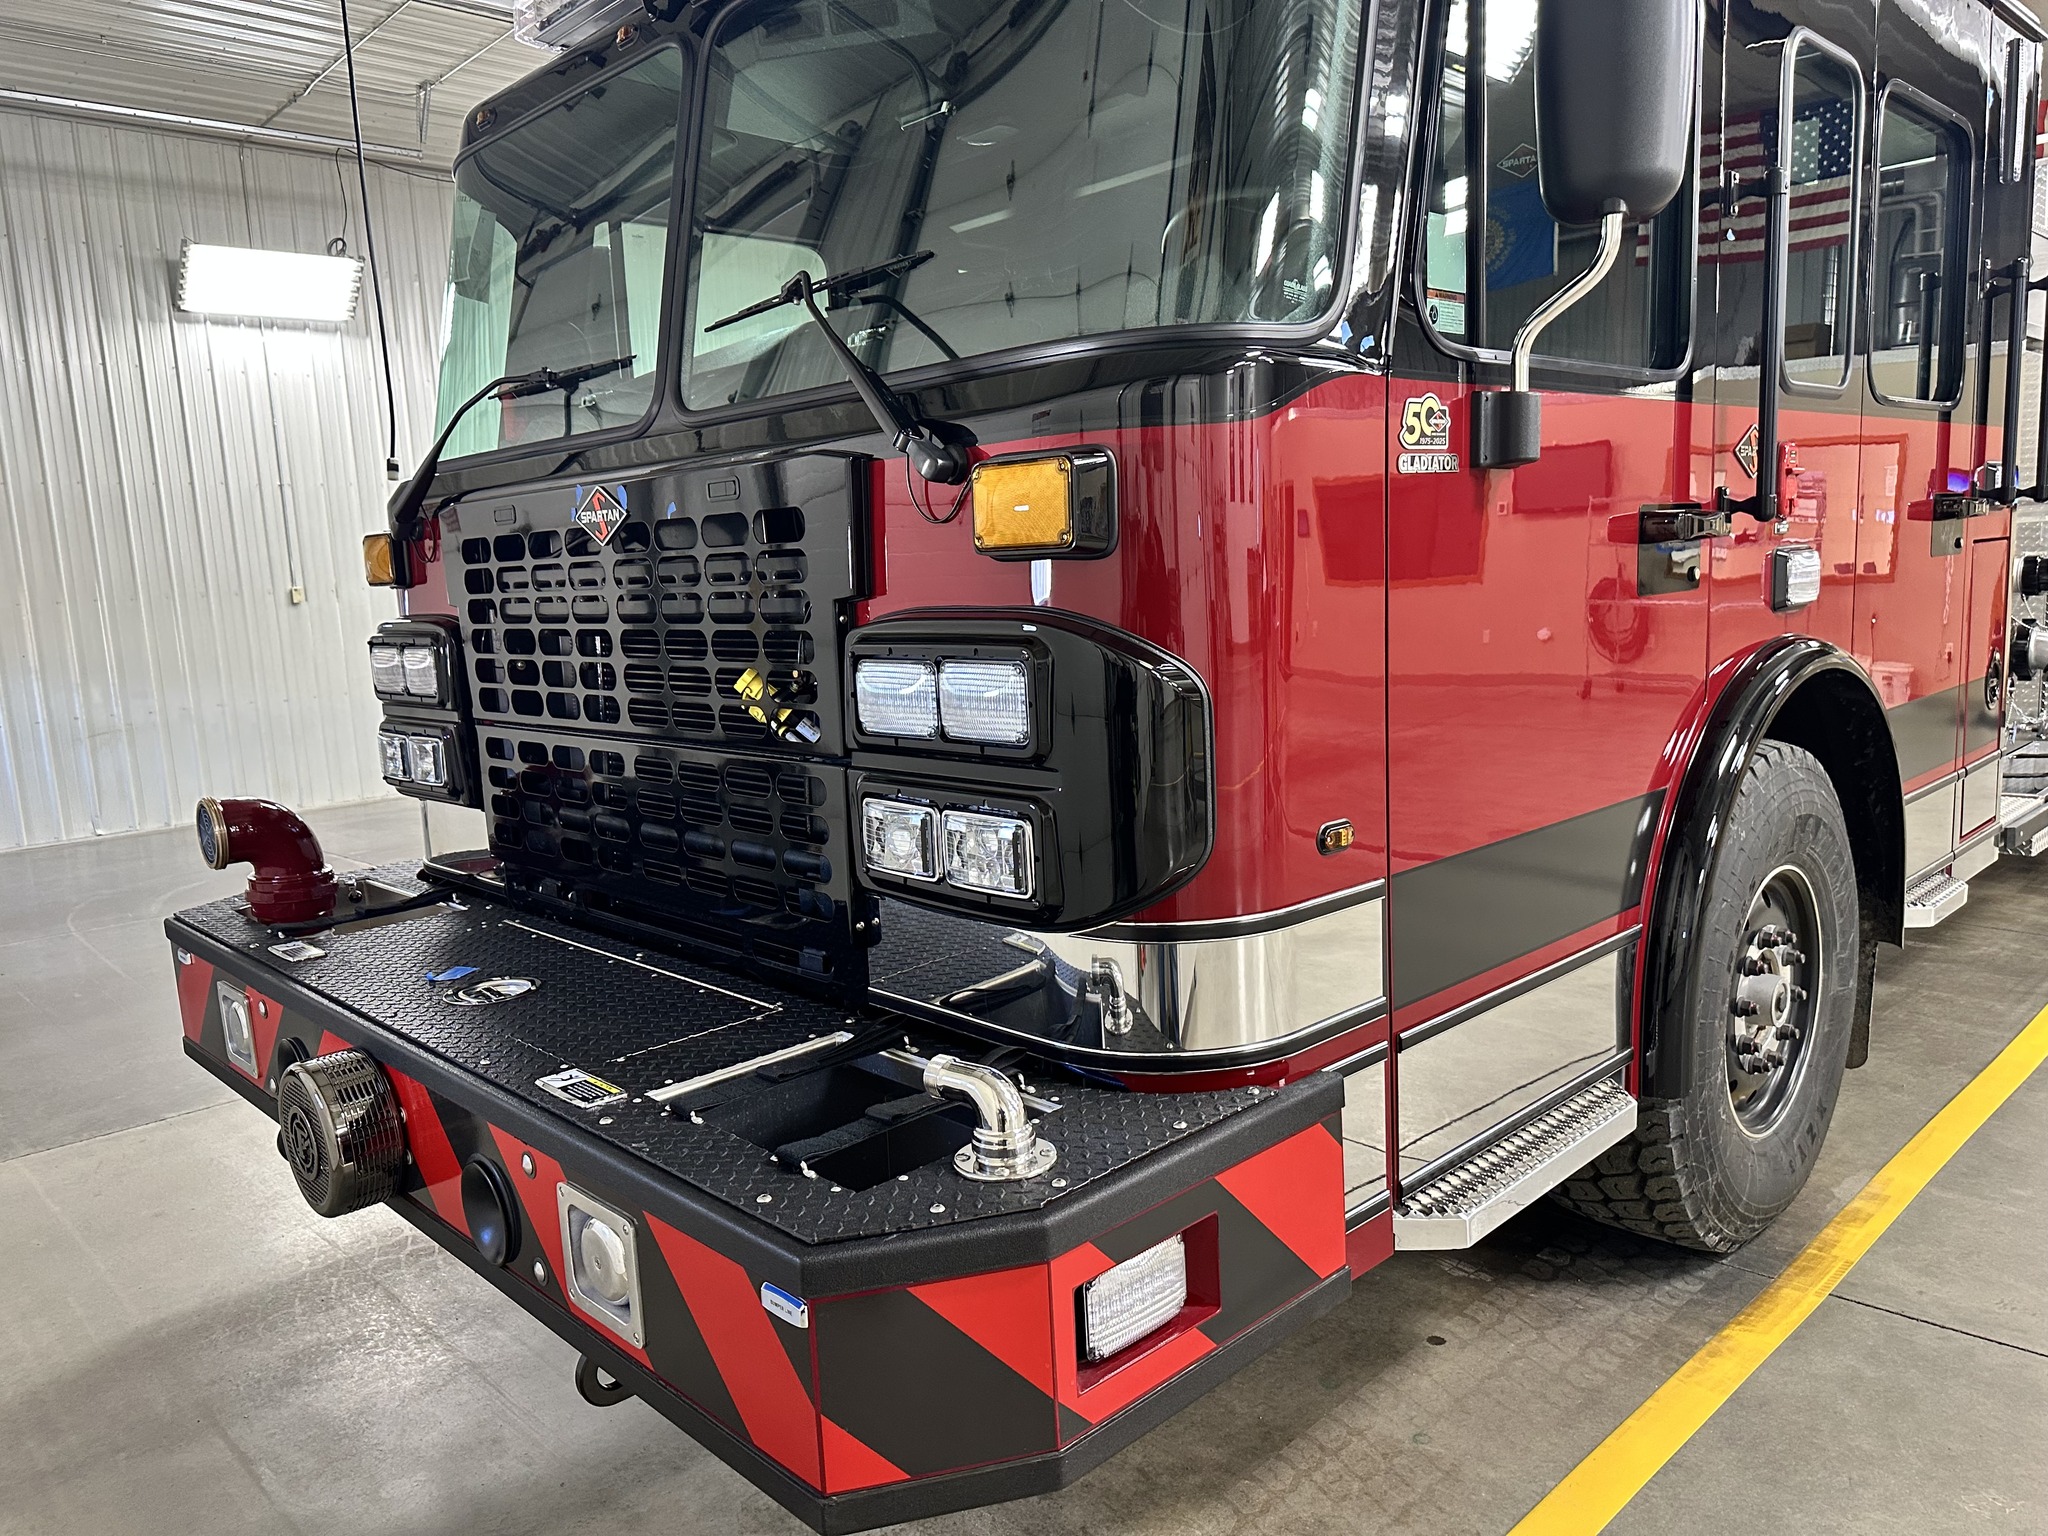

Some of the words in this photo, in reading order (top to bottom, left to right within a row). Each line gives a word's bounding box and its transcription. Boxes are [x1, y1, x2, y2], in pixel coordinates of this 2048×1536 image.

[1502, 155, 1537, 168] SPARTA
[1402, 396, 1441, 445] 50
[1419, 437, 1446, 445] 1975-2025
[1740, 445, 1759, 457] SPAR
[1399, 453, 1459, 472] GLADIATOR
[580, 509, 620, 524] SPARTAN
